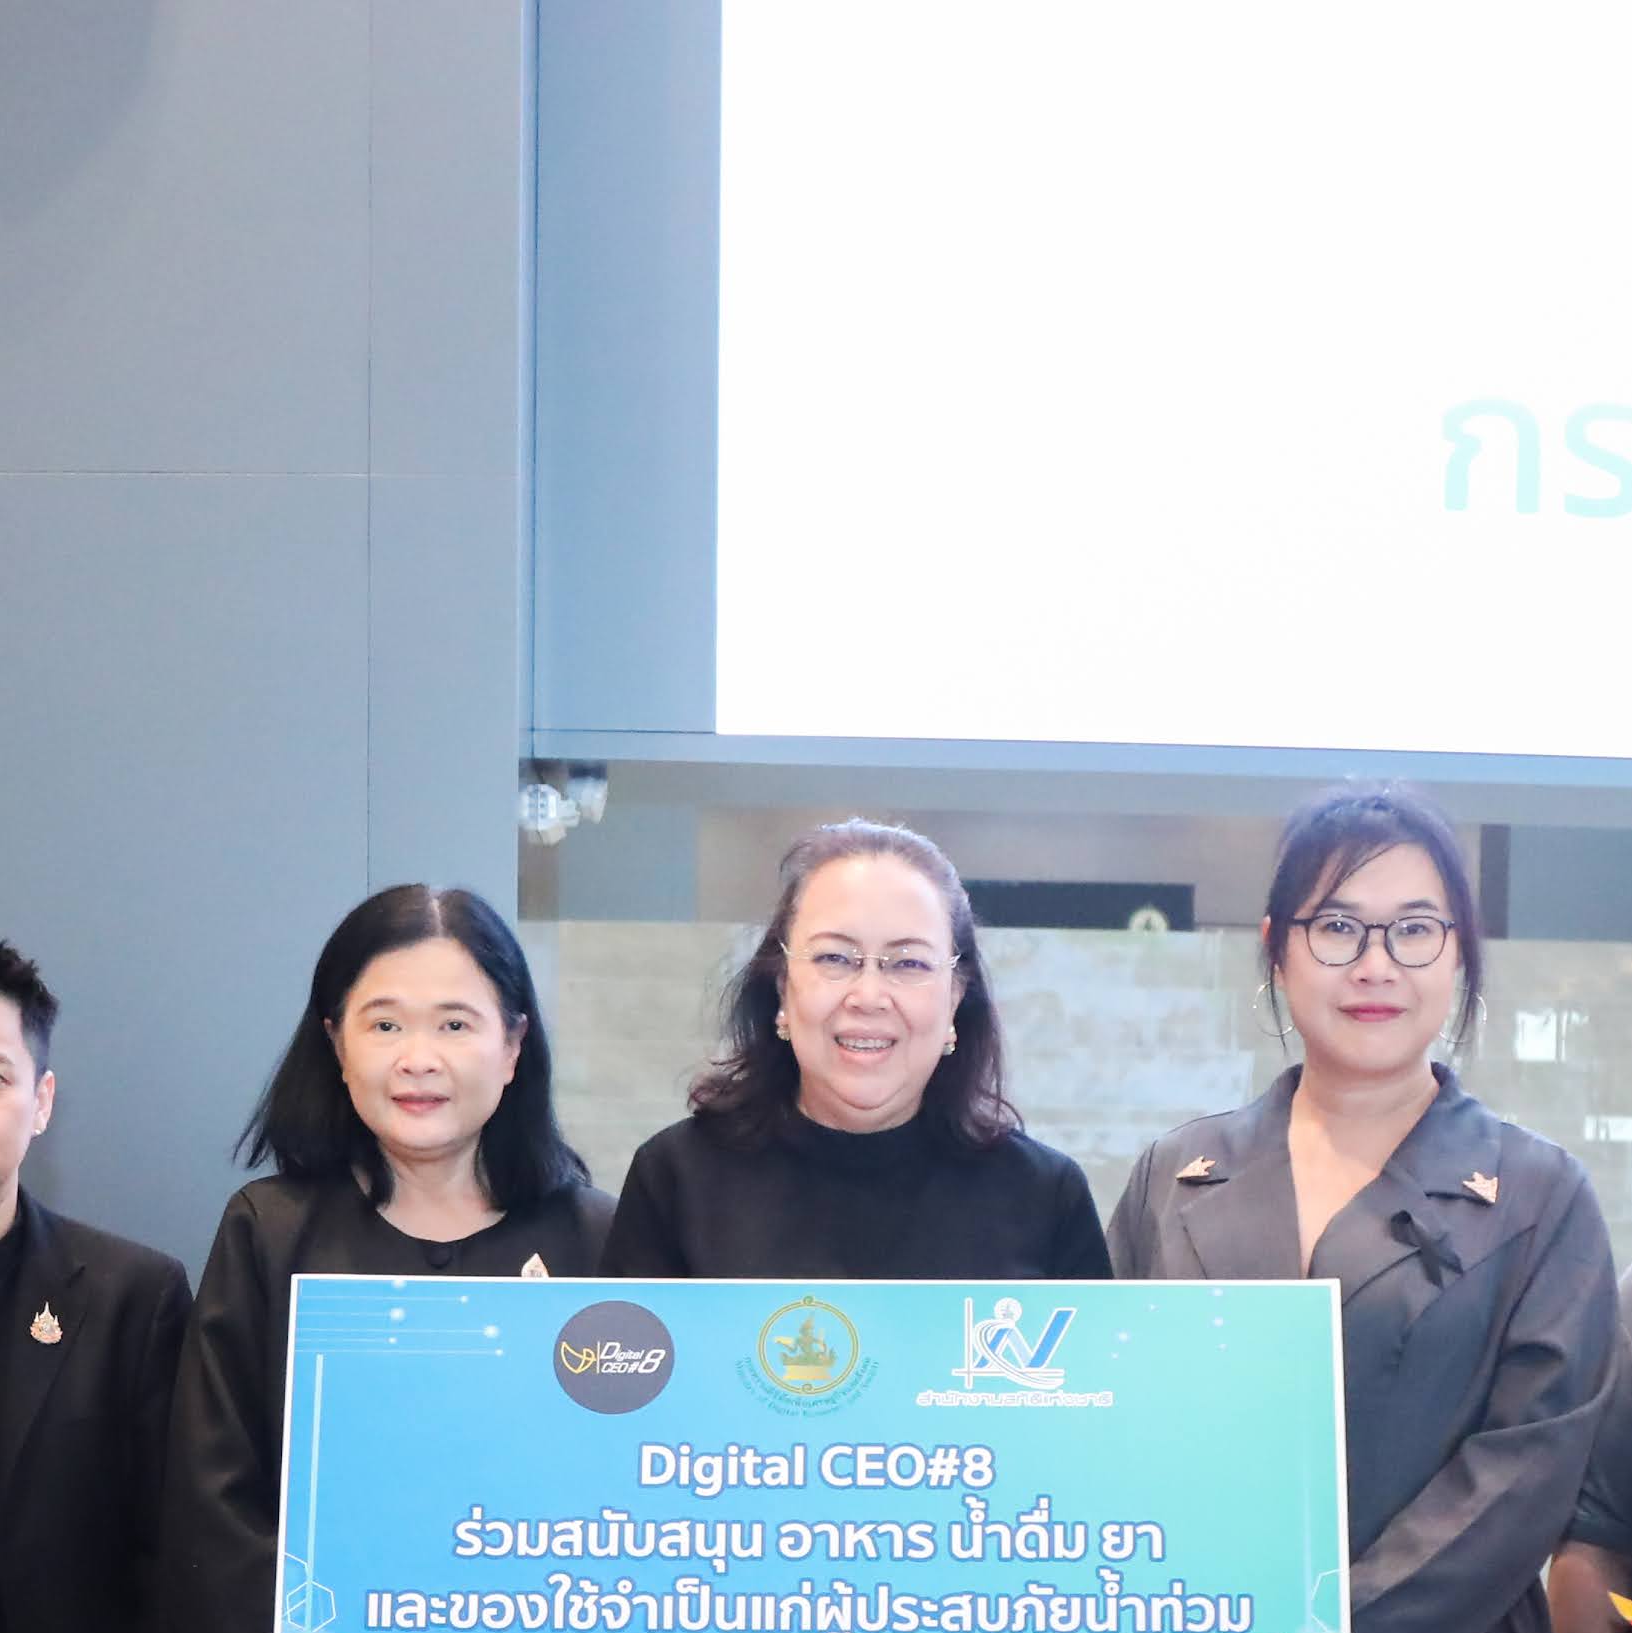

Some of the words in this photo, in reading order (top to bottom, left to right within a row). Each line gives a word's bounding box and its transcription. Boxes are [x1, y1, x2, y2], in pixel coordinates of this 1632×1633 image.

[641, 1444, 805, 1496] Digital
[821, 1445, 994, 1488] CEO#8
[455, 1506, 763, 1573] ร่วมสนับสนุน
[778, 1520, 935, 1560] อาหาร
[950, 1496, 1087, 1560] น้ำดื่ม
[1100, 1521, 1164, 1560] ยา
